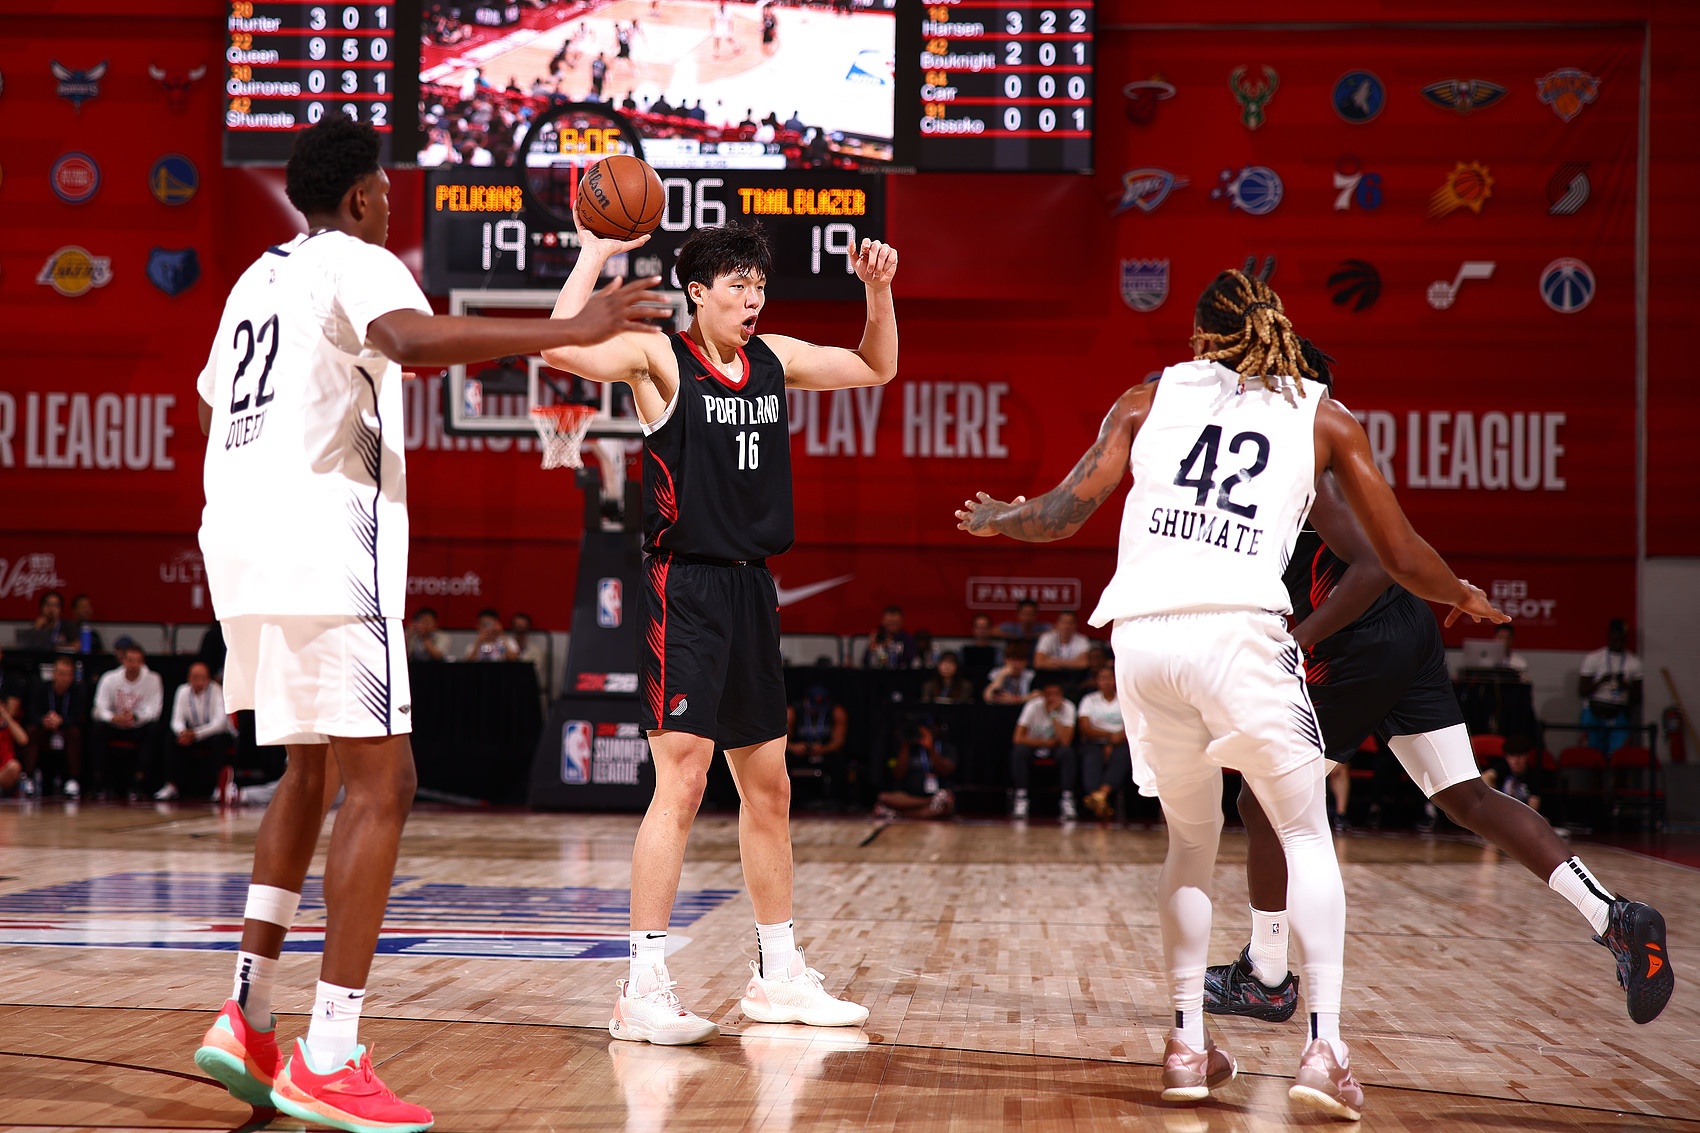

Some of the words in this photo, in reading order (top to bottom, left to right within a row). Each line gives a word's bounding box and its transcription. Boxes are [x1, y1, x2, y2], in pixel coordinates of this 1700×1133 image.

[309, 7, 327, 30] 3
[342, 6, 359, 30] 0
[374, 6, 387, 29] 1
[1005, 11, 1023, 35] 3
[1039, 10, 1057, 34] 2
[1069, 9, 1086, 33] 2
[226, 46, 280, 64] Queen
[309, 37, 326, 60] 9
[342, 38, 359, 62] 5
[370, 37, 388, 61] 0
[231, 33, 253, 50] 22
[925, 38, 949, 55] 42
[1005, 41, 1022, 65] 2
[1039, 42, 1056, 66] 0
[1072, 42, 1085, 65] 1
[230, 65, 252, 82] 30
[308, 69, 326, 94] 0
[341, 70, 358, 94] 3
[373, 71, 386, 95] 1
[920, 84, 958, 101] Carr
[1004, 74, 1022, 99] 0
[1038, 74, 1056, 99] 0
[1067, 76, 1085, 100] 0
[226, 109, 295, 128] Shumate
[307, 102, 325, 124] 0
[370, 102, 387, 126] 2
[229, 96, 251, 114] 42
[1003, 107, 1021, 131] 0
[1039, 108, 1056, 132] 0
[1072, 108, 1085, 131] 1
[559, 128, 621, 155] 8:06
[435, 185, 523, 212] PELICANS
[737, 187, 792, 215] TRAIL
[1333, 172, 1384, 211] 76
[482, 219, 527, 271] 19
[811, 222, 856, 274] 19
[230, 313, 280, 415] 22
[701, 394, 779, 425] PORTLAND
[786, 385, 884, 457] PLAY
[903, 381, 1009, 459] HERE
[25, 391, 176, 471] LEAGUE
[225, 409, 268, 452] QUEEN
[735, 431, 760, 470] 16
[1407, 410, 1567, 492] LEAGUE
[1173, 424, 1271, 520] 42
[1148, 507, 1264, 556] SHUMATE
[407, 570, 482, 597] crosoft
[975, 584, 1072, 603] PANINI
[593, 737, 649, 763] SUMMER
[592, 761, 640, 785] LEAGUE
